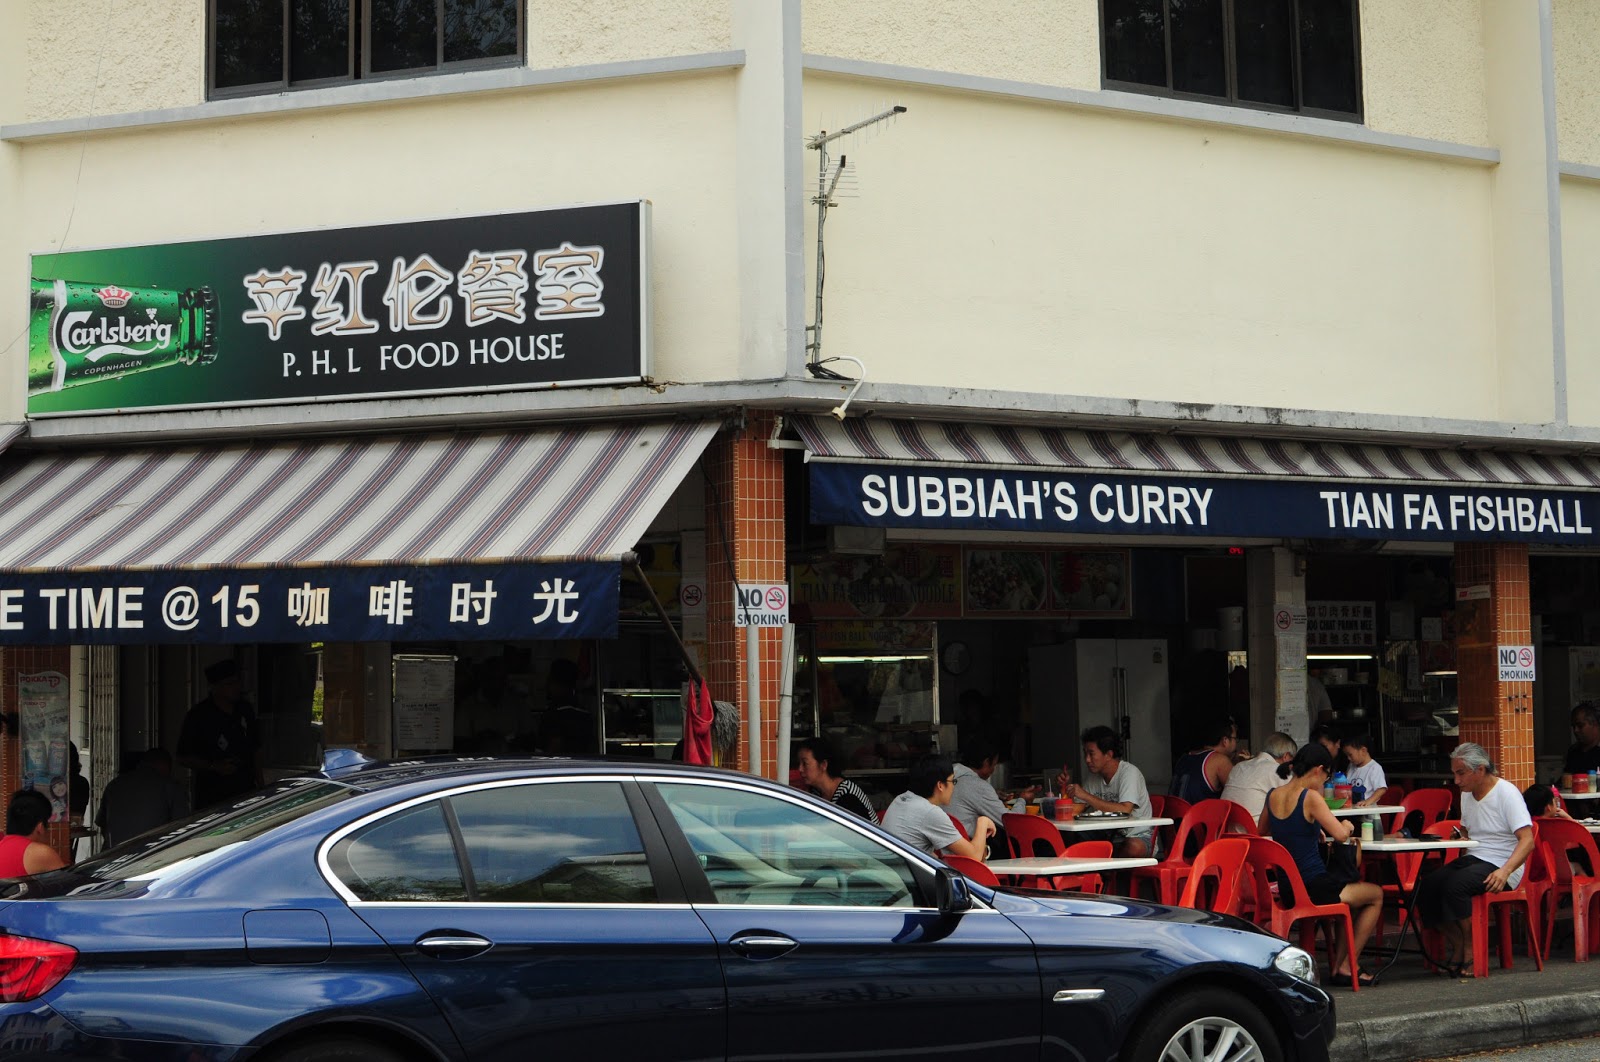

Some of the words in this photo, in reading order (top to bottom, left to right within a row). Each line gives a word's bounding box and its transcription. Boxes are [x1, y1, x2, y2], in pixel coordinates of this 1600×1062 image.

[243, 243, 605, 340] 苹红伦餐室
[61, 310, 172, 354] Carlsberg
[84, 360, 142, 375] COPENHAGEN
[283, 352, 301, 377] P.
[312, 350, 337, 375] H.
[348, 348, 361, 373] L
[380, 341, 459, 371] FOOD
[469, 333, 566, 365] HOUSE
[861, 474, 1078, 522] SUBBIAH'S
[1090, 483, 1213, 526] CURRY
[1320, 491, 1394, 529] TIAN
[1403, 493, 1443, 531] FA
[1449, 495, 1592, 534] FISHBALL
[39, 587, 145, 630] TIME
[738, 589, 763, 607] NO
[738, 614, 787, 625] SMOKING
[1500, 649, 1517, 665] NO
[1500, 670, 1534, 680] SMOKING
